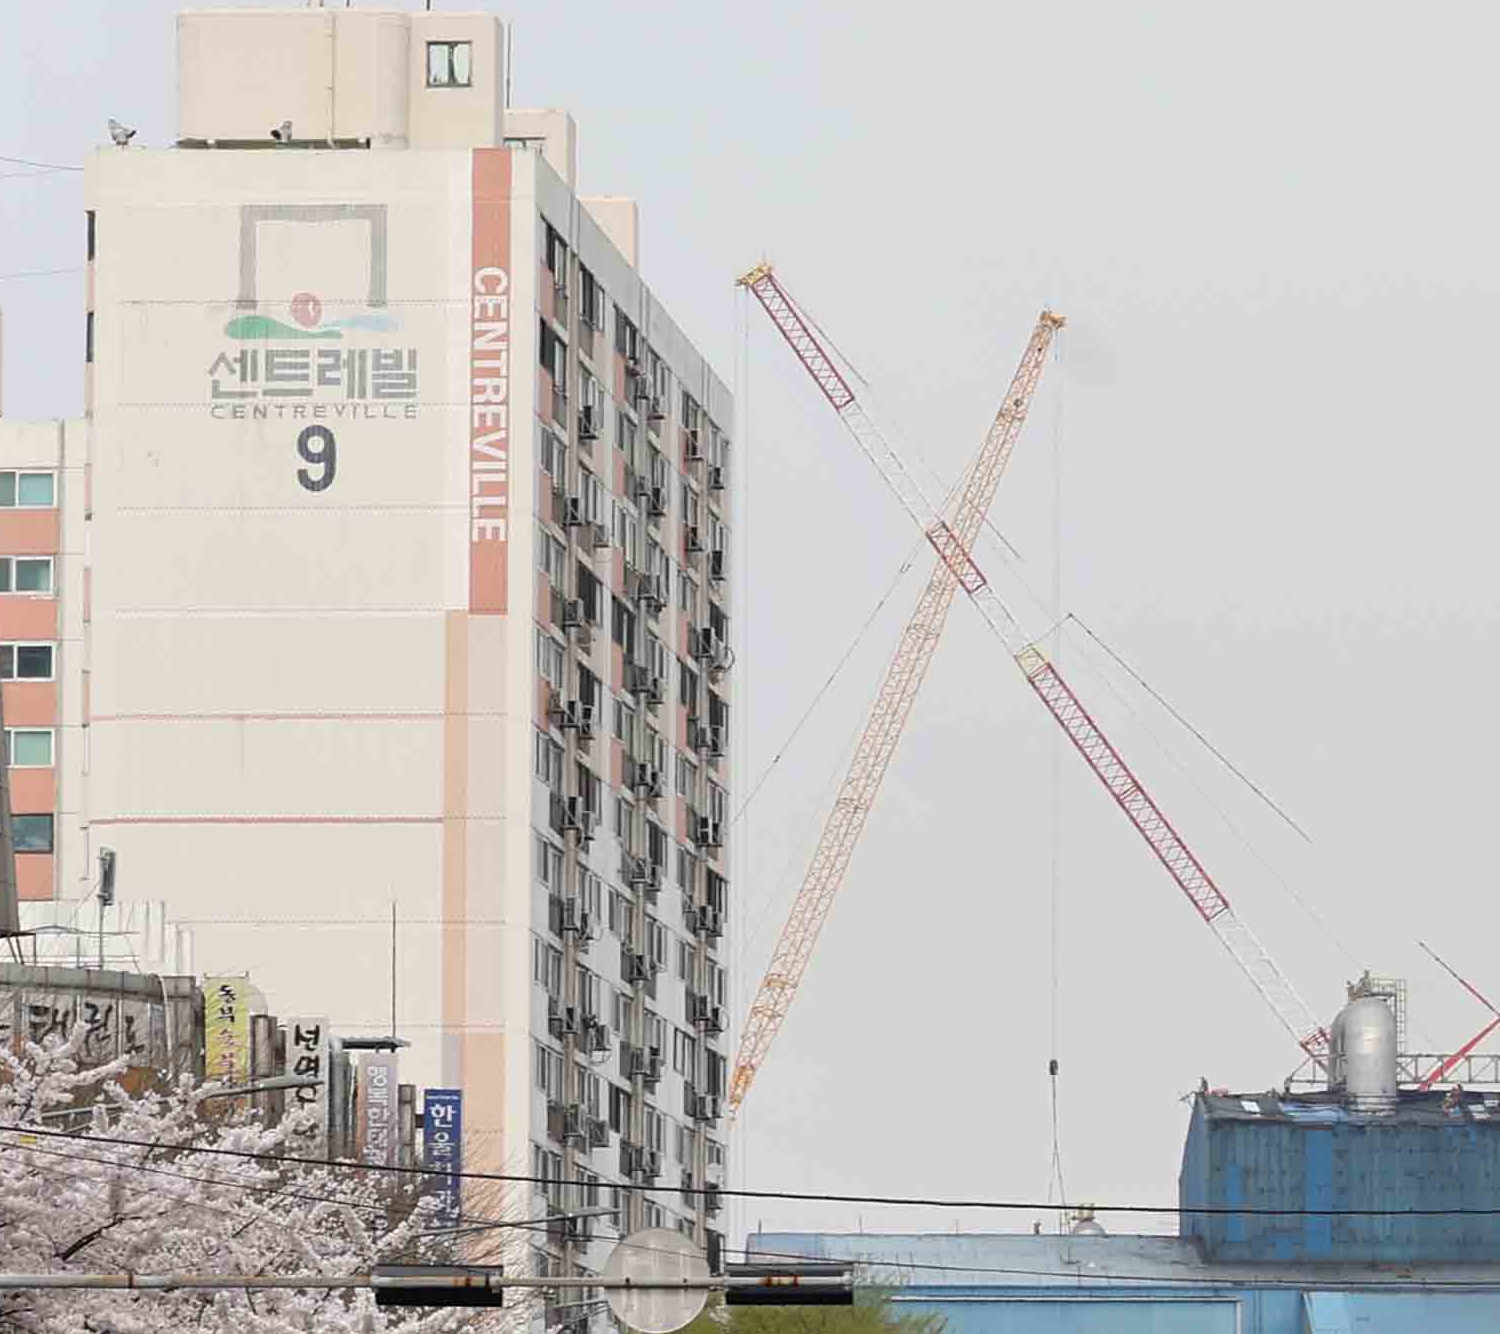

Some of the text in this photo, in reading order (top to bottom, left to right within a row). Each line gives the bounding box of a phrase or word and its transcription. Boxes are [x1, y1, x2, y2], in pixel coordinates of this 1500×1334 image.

[206, 349, 418, 399] 센트레빌
[210, 403, 418, 420] CENTREVILLE
[473, 265, 508, 544] CENTREVILLE
[296, 425, 337, 492] 9
